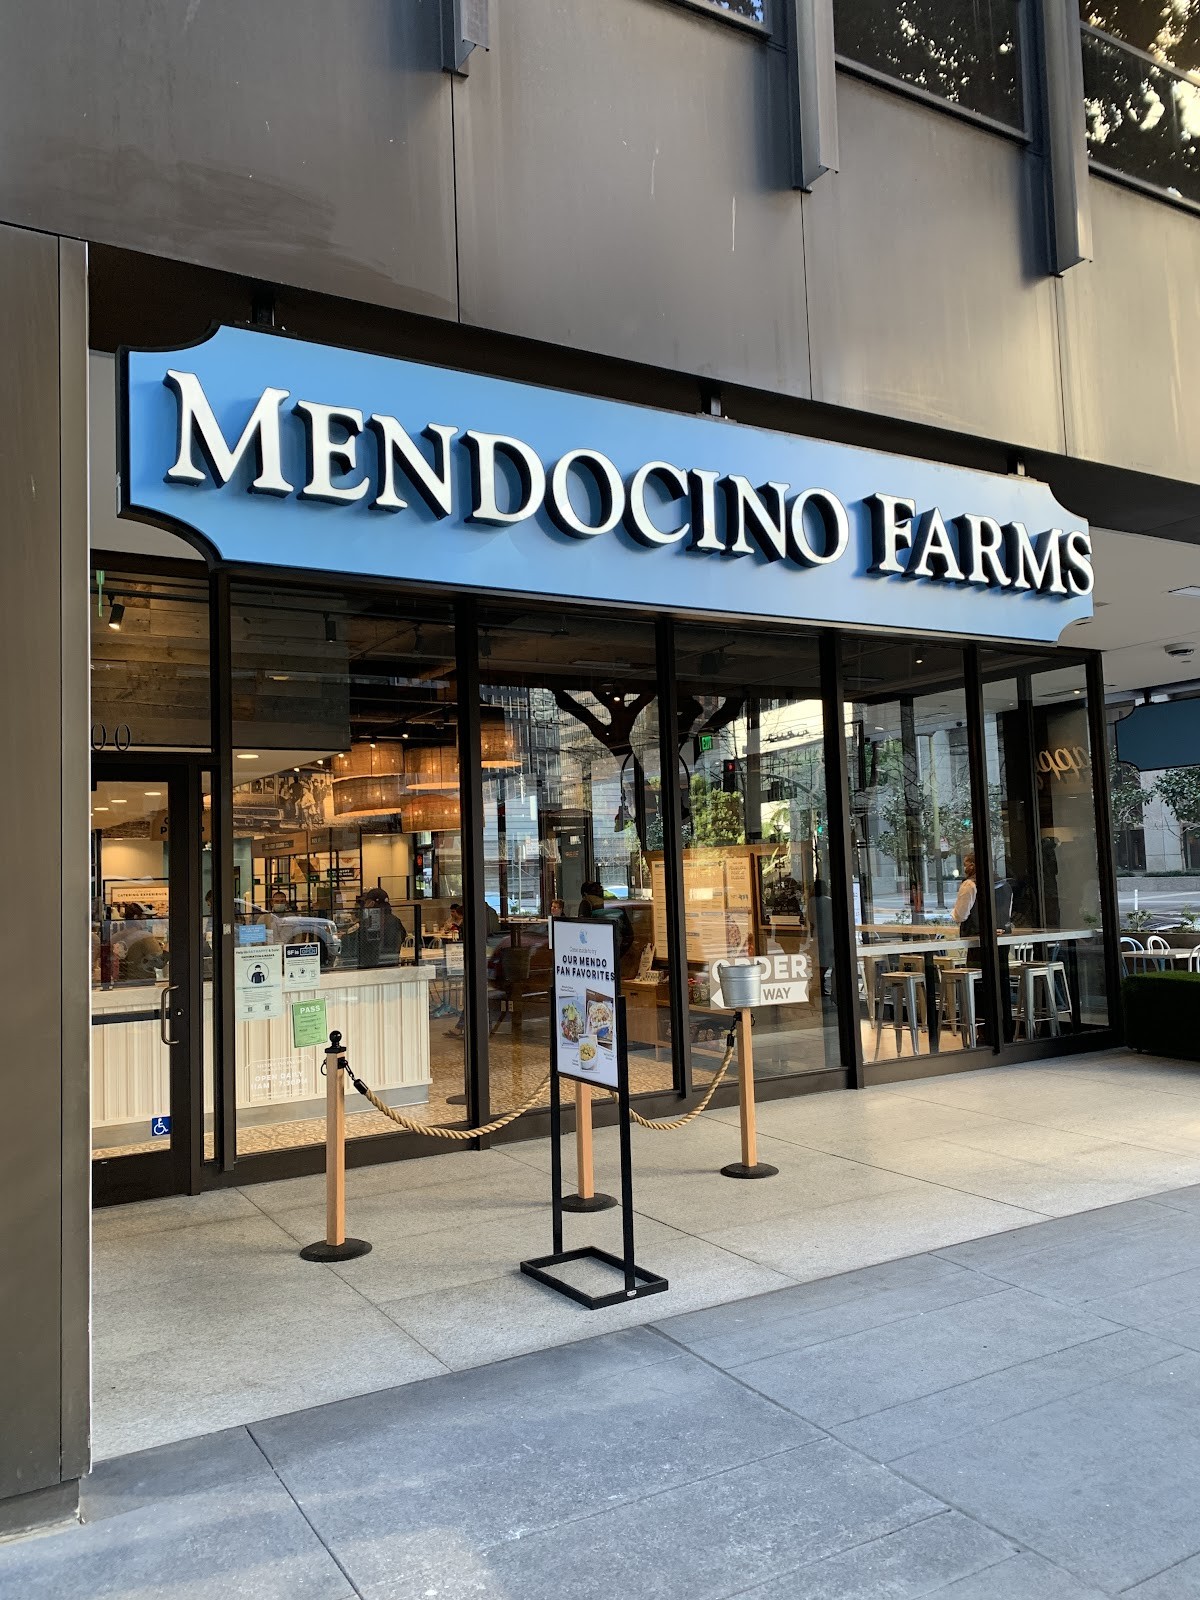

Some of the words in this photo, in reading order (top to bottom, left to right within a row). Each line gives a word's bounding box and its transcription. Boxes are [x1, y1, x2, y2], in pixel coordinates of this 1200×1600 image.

[164, 370, 850, 567] MENDOCINO
[868, 491, 1094, 598] FARMS
[562, 954, 578, 965] OUR
[579, 956, 607, 968] MENDO
[556, 965, 571, 977] FAN
[572, 967, 616, 981] FAVORITES
[711, 954, 808, 984] ODER
[763, 987, 792, 1001] WAY
[300, 1004, 321, 1014] PASS
[255, 1074, 278, 1082] OPEN
[280, 1071, 304, 1079] DAILY
